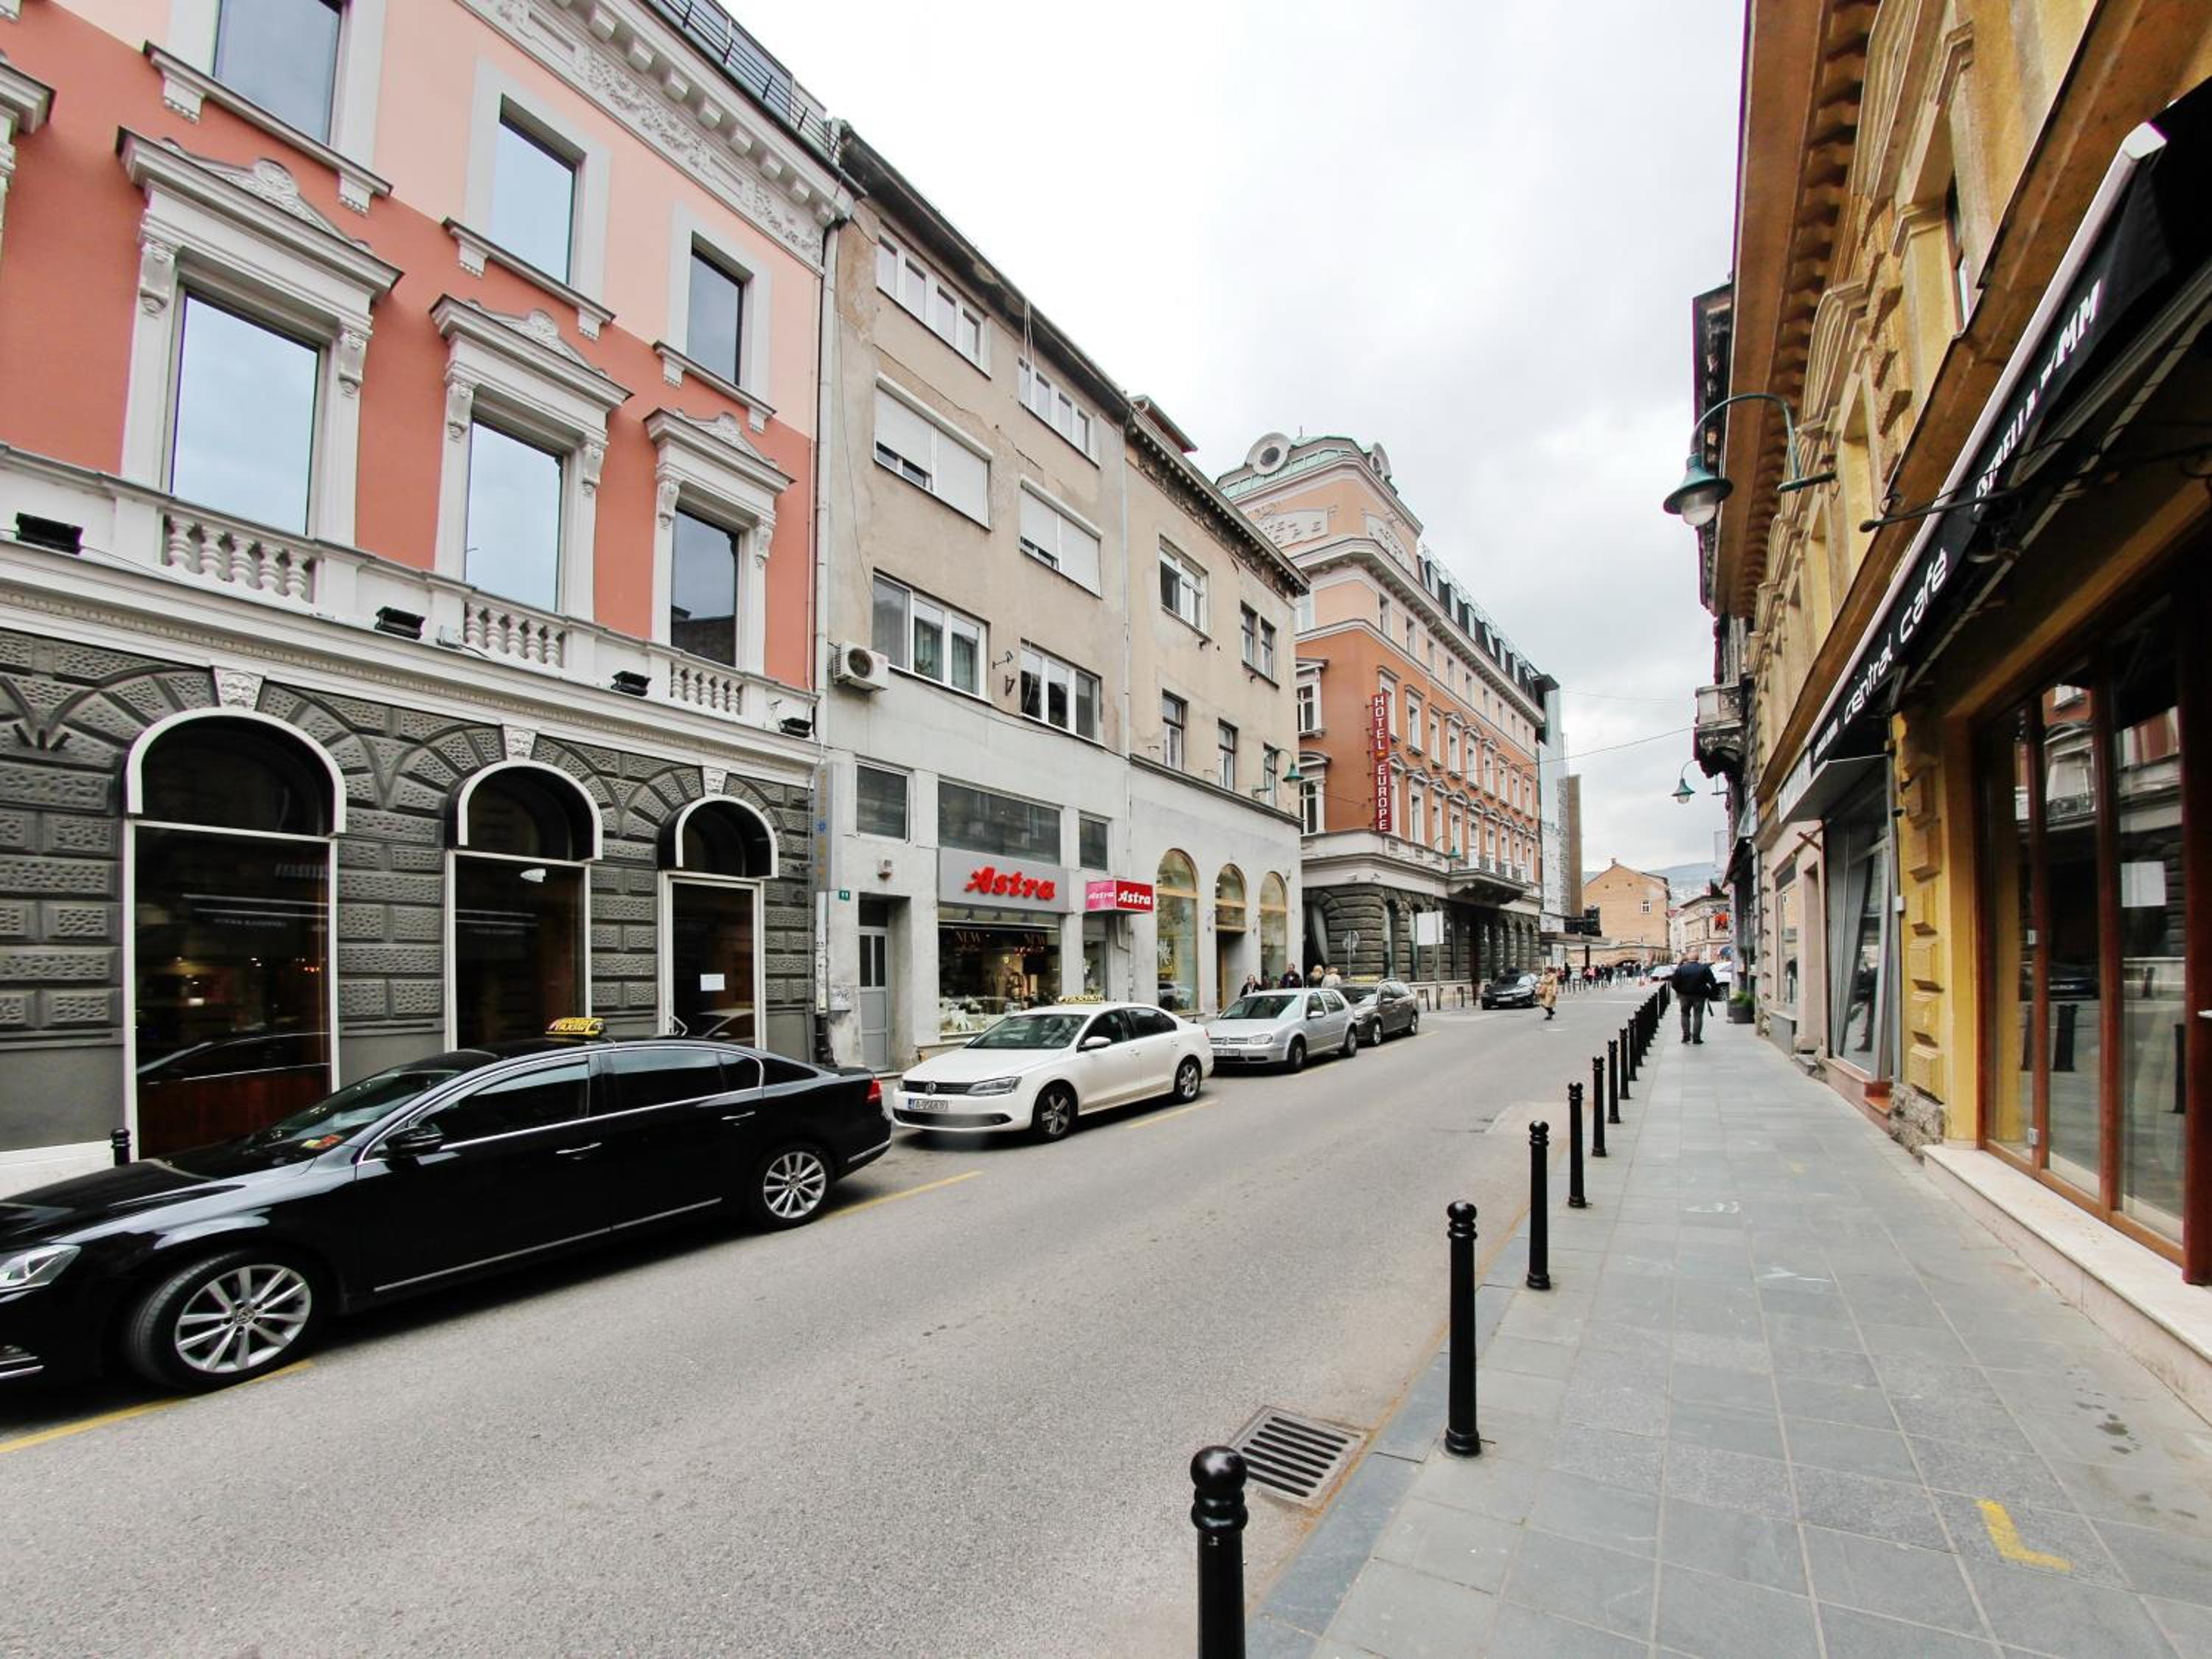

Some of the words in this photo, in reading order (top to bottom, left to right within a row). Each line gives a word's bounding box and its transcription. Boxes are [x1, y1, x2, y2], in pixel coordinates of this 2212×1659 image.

[1843, 633, 1893, 725] central
[1899, 547, 1947, 644] café
[1374, 695, 1385, 751] HOTEL
[1377, 764, 1388, 830] EUROPE
[964, 865, 1055, 901] Astra
[1117, 889, 1151, 905] Astra
